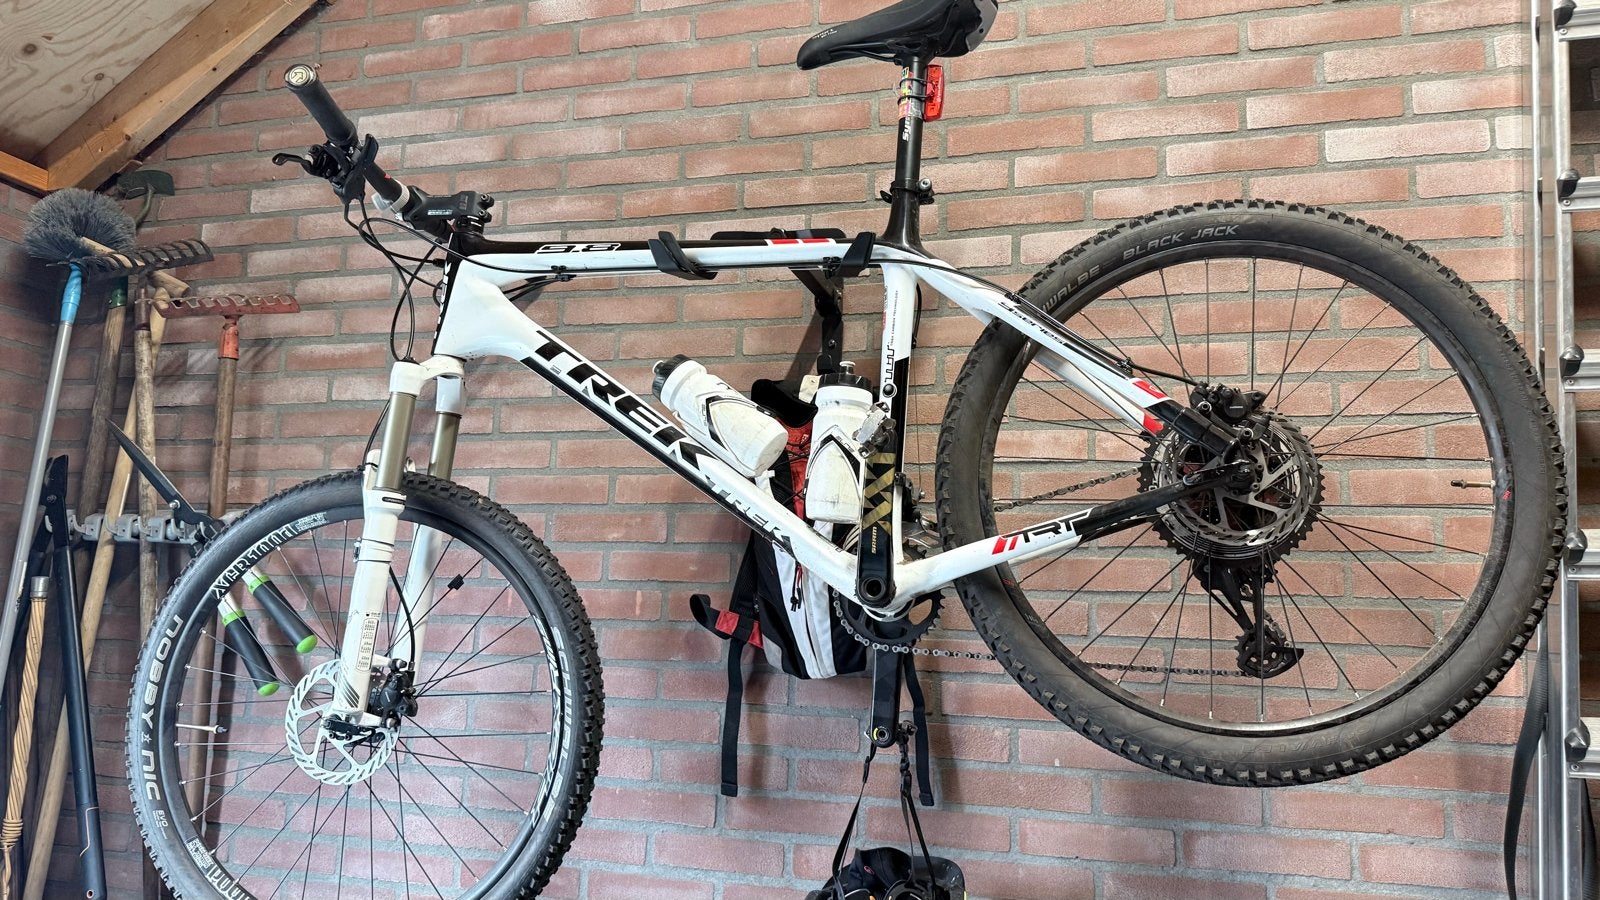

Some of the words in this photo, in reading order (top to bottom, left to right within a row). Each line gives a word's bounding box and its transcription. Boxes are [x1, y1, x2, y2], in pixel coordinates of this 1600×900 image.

[1122, 231, 1183, 261] BLACK
[1190, 224, 1240, 241] JACK
[534, 330, 719, 471] TREK
[140, 613, 182, 723] NOBBY
[142, 745, 161, 802] NIC
[542, 626, 573, 823] SCHWALBE
